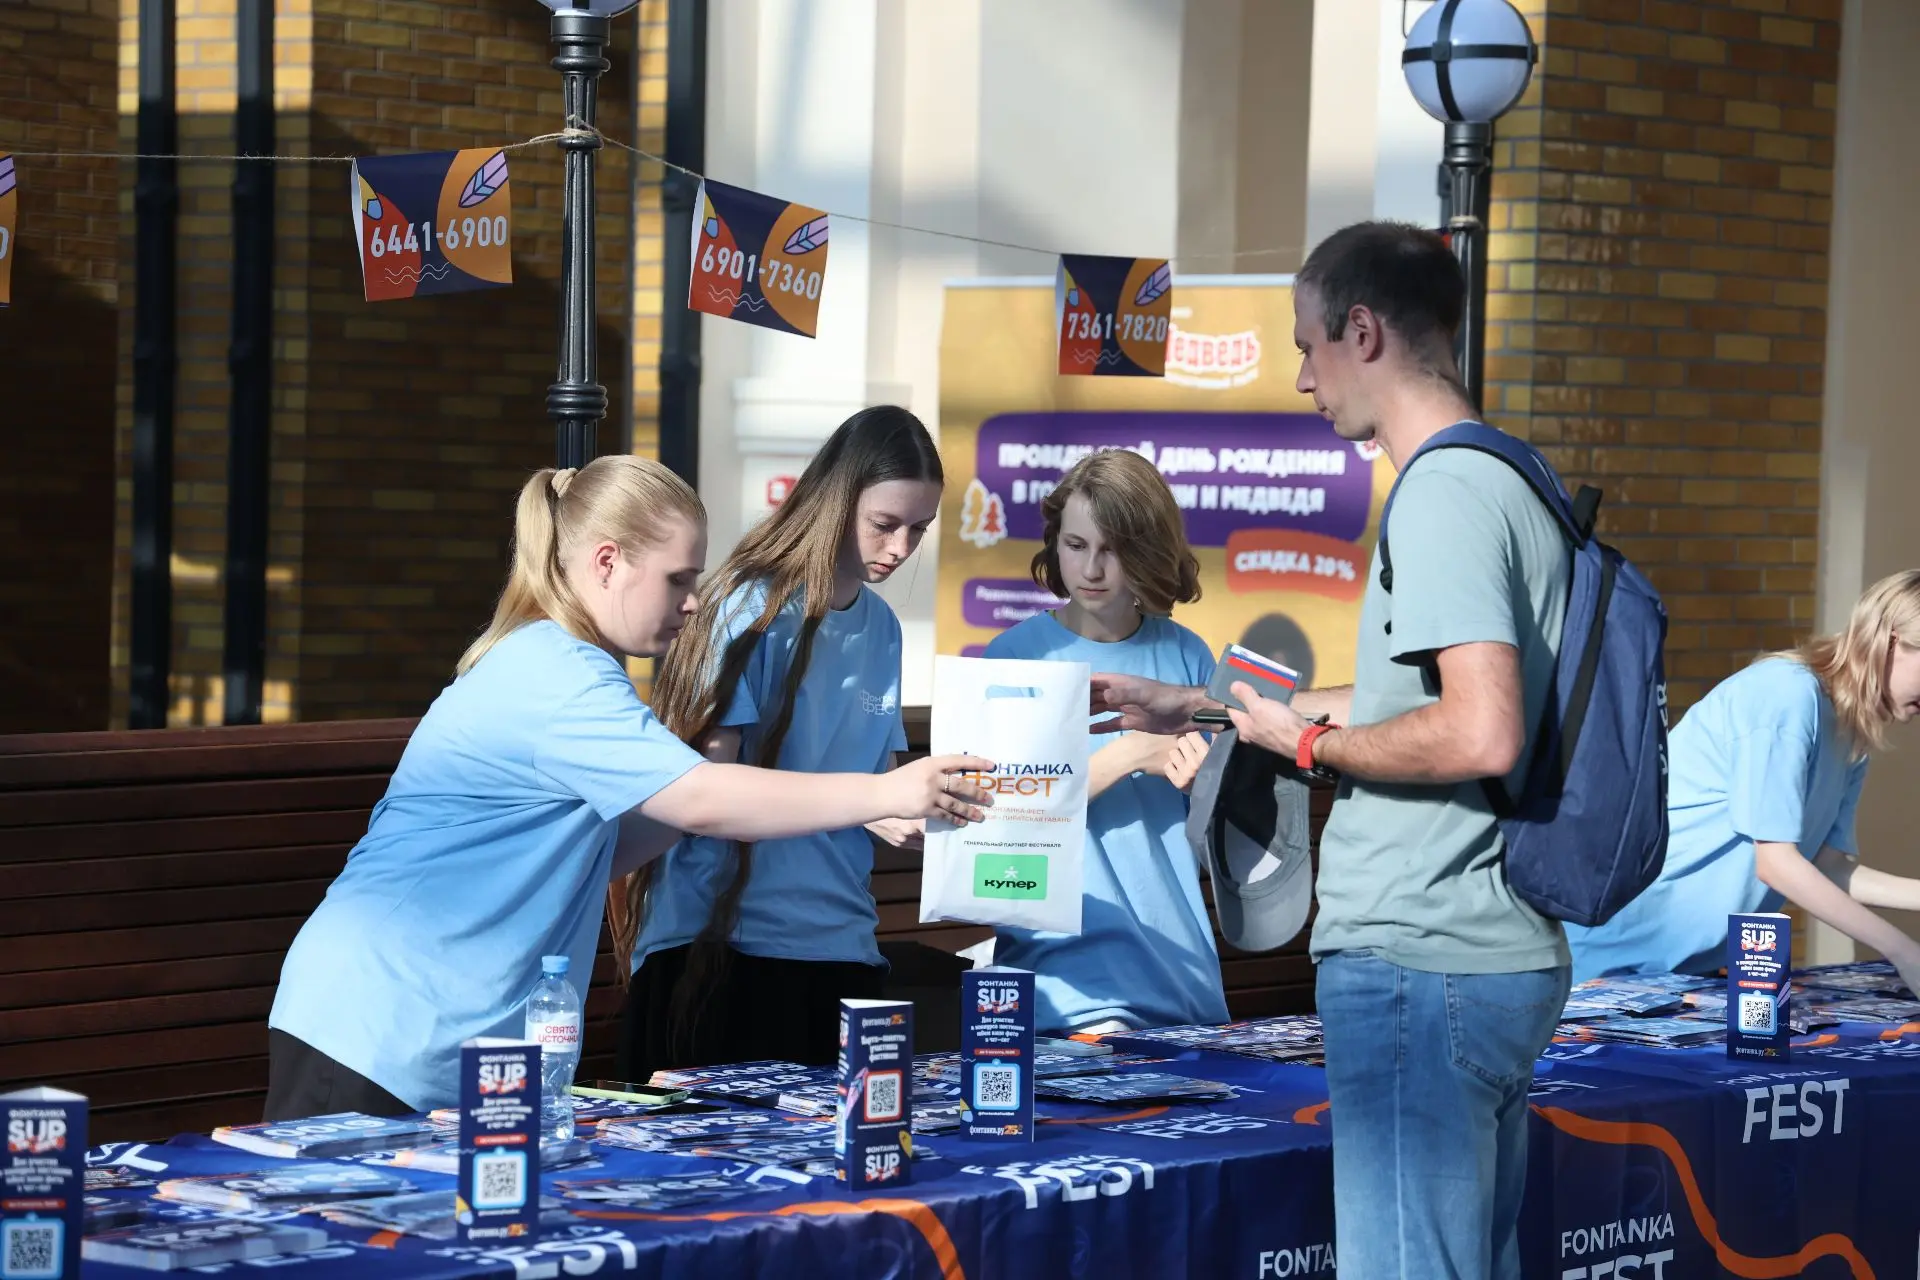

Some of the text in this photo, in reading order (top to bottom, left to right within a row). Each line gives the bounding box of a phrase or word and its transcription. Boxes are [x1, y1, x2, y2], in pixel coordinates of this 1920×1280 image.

[371, 216, 507, 258] 6441-6900
[701, 244, 822, 301] 6901-7360
[1068, 312, 1169, 343] 7361-7820
[1157, 447, 1217, 476] ДЕНЬ
[1218, 448, 1347, 478] РОЖДЕНИЯ
[1200, 485, 1219, 510] И
[1220, 485, 1326, 516] МЕДВЕДЯ
[1235, 550, 1356, 582] СКИДКА 20%
[984, 879, 1038, 891] купер
[1741, 922, 1777, 930] ФОНТАНКА
[1741, 929, 1777, 946] SUP
[977, 980, 1020, 988] ФОНТАНКА
[977, 987, 1020, 1006] SUP
[544, 1025, 578, 1035] СВЯТО
[478, 1063, 528, 1089] SUP
[1742, 1078, 1850, 1144] FEST
[8, 1119, 68, 1143] SUP
[865, 1152, 901, 1175] SUP
[1561, 1212, 1675, 1259] FONTANKA
[1259, 1241, 1337, 1280] FONTA
